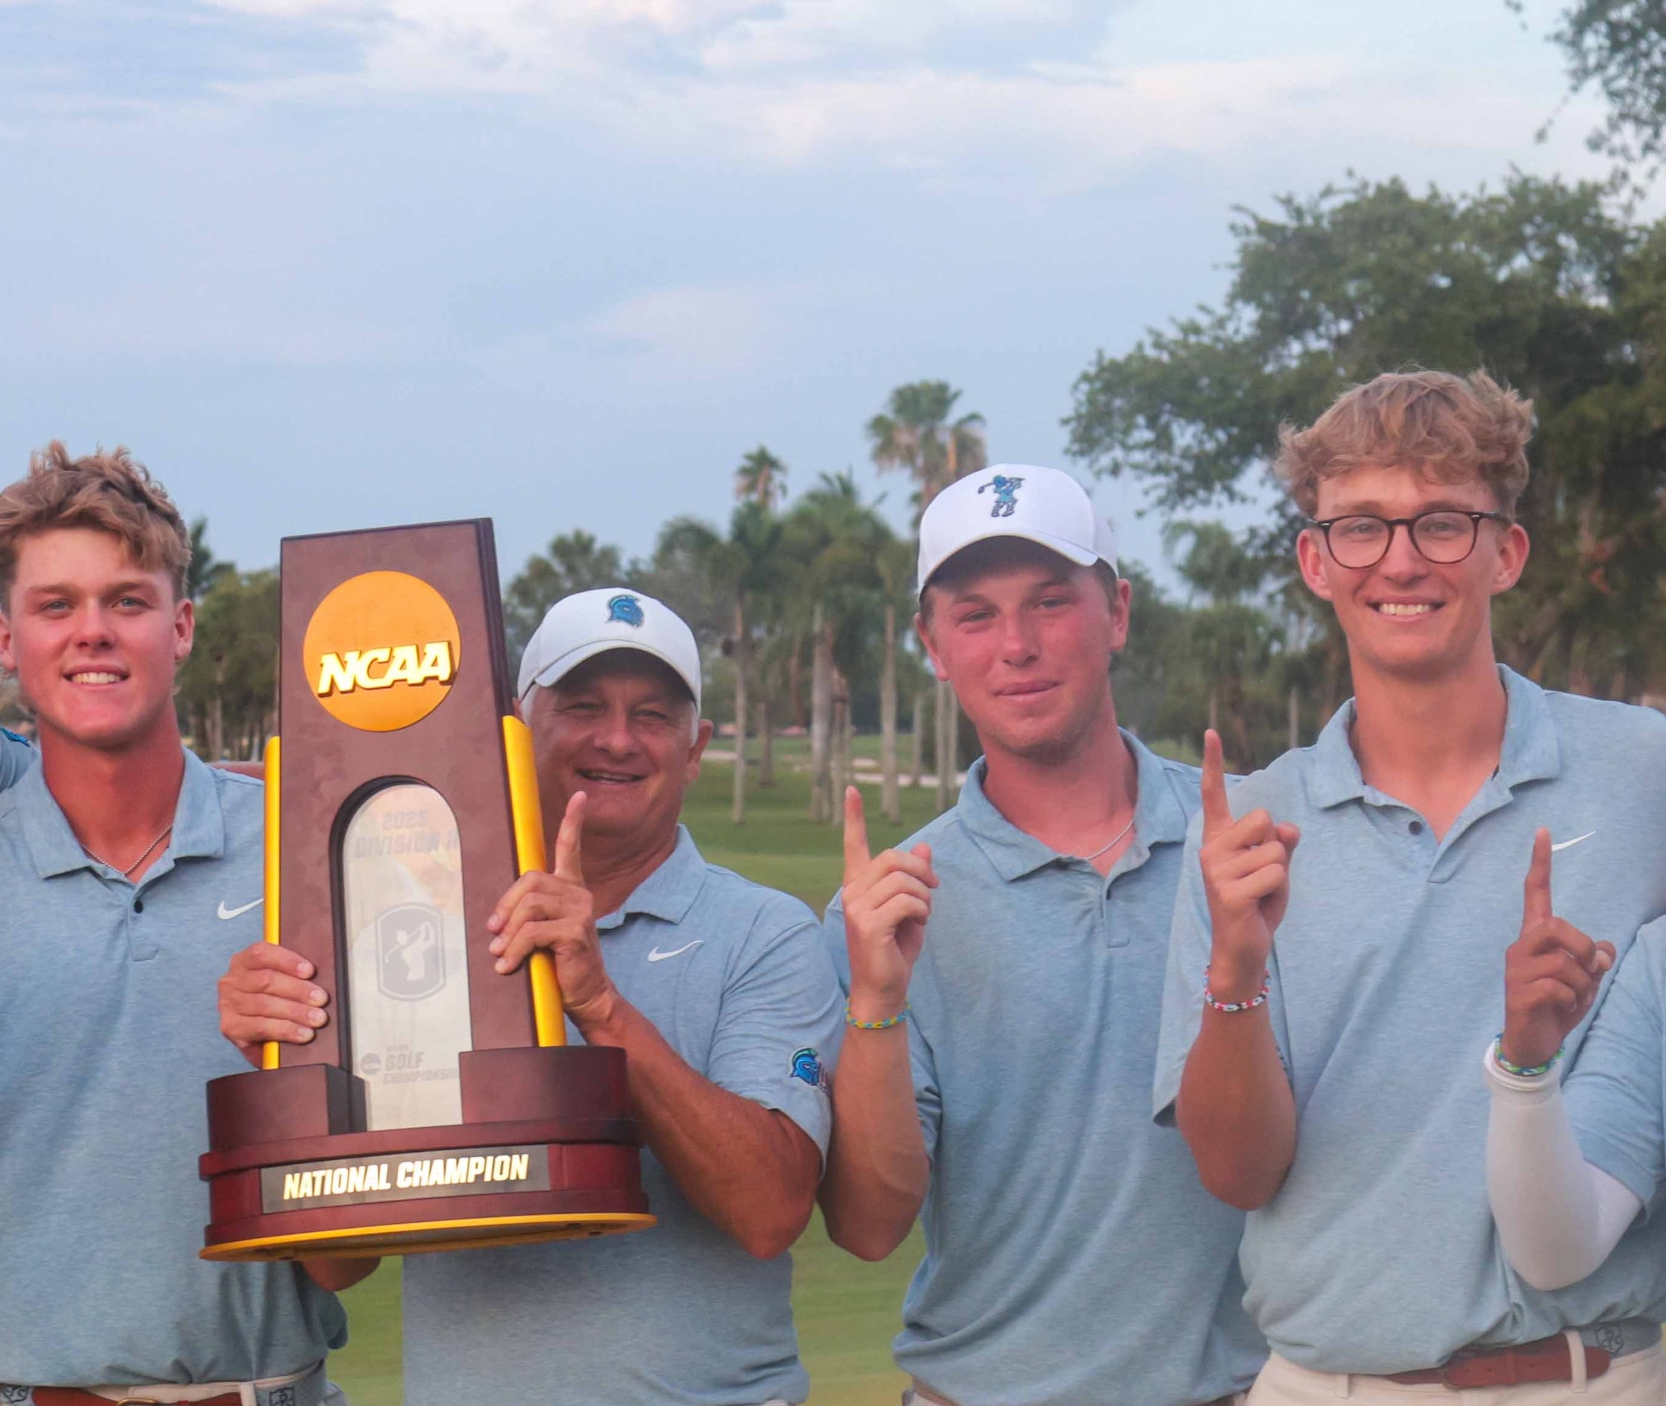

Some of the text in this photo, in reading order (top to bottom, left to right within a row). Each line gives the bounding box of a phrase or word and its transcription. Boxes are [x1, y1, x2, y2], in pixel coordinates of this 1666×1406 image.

[317, 640, 453, 697] NCAA
[384, 1050, 425, 1071] GOLF
[283, 1153, 529, 1200] NATIONAL CHAMPION
